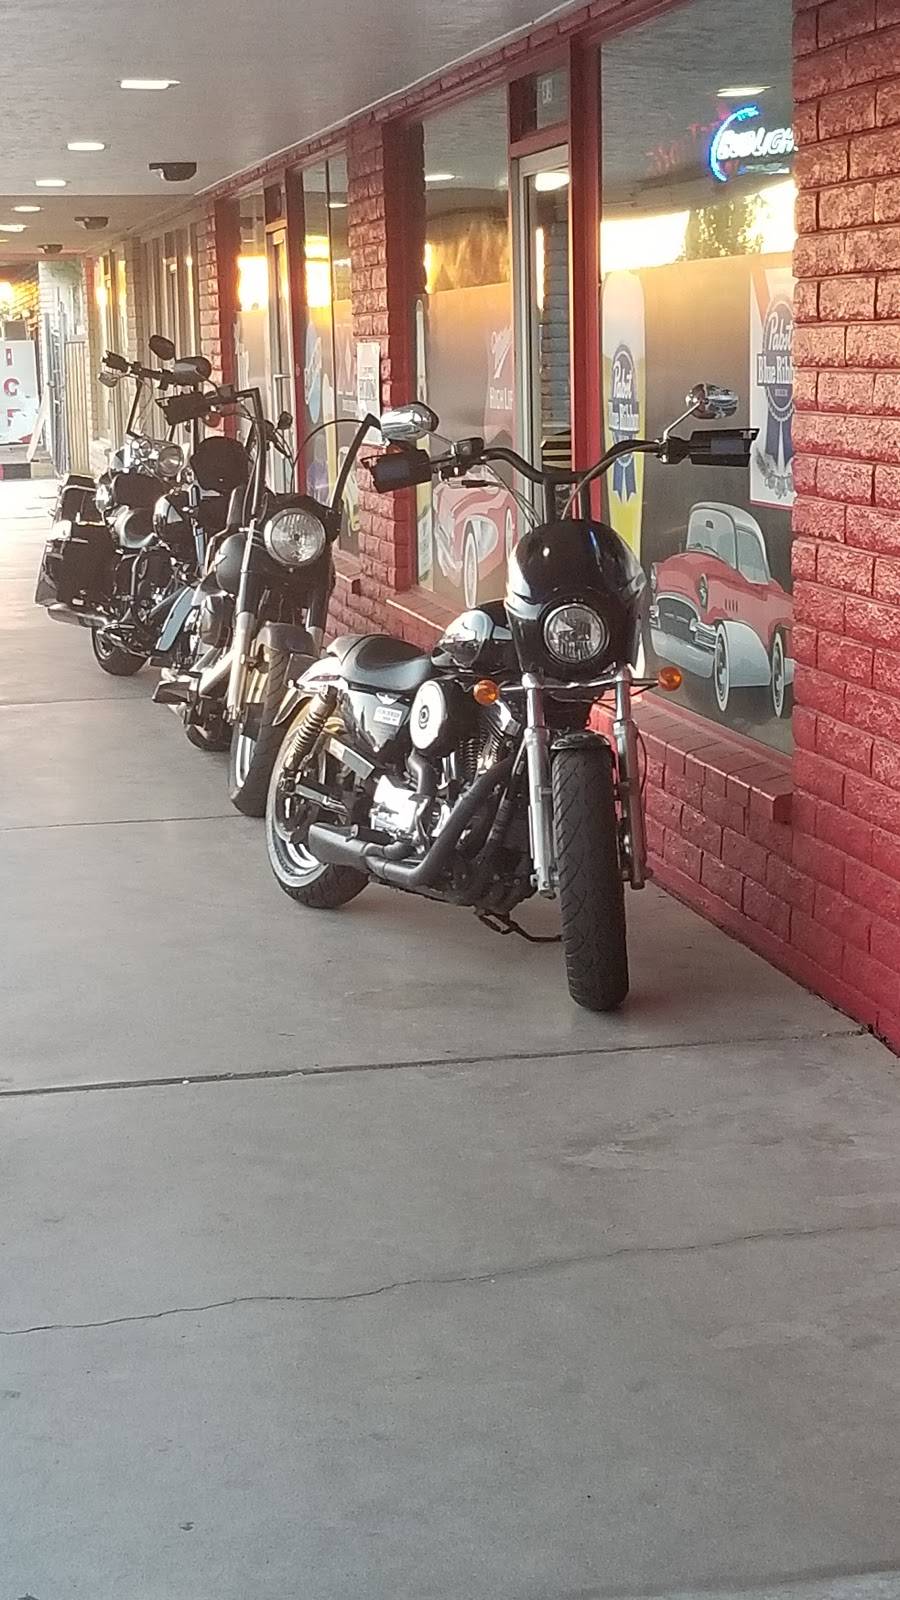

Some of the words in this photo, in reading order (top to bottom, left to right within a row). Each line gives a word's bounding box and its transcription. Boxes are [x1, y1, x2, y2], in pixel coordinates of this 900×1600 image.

[754, 126, 793, 156] LIGH
[768, 311, 793, 351] Pabst
[758, 355, 776, 384] Blue
[776, 355, 793, 384] Ribb
